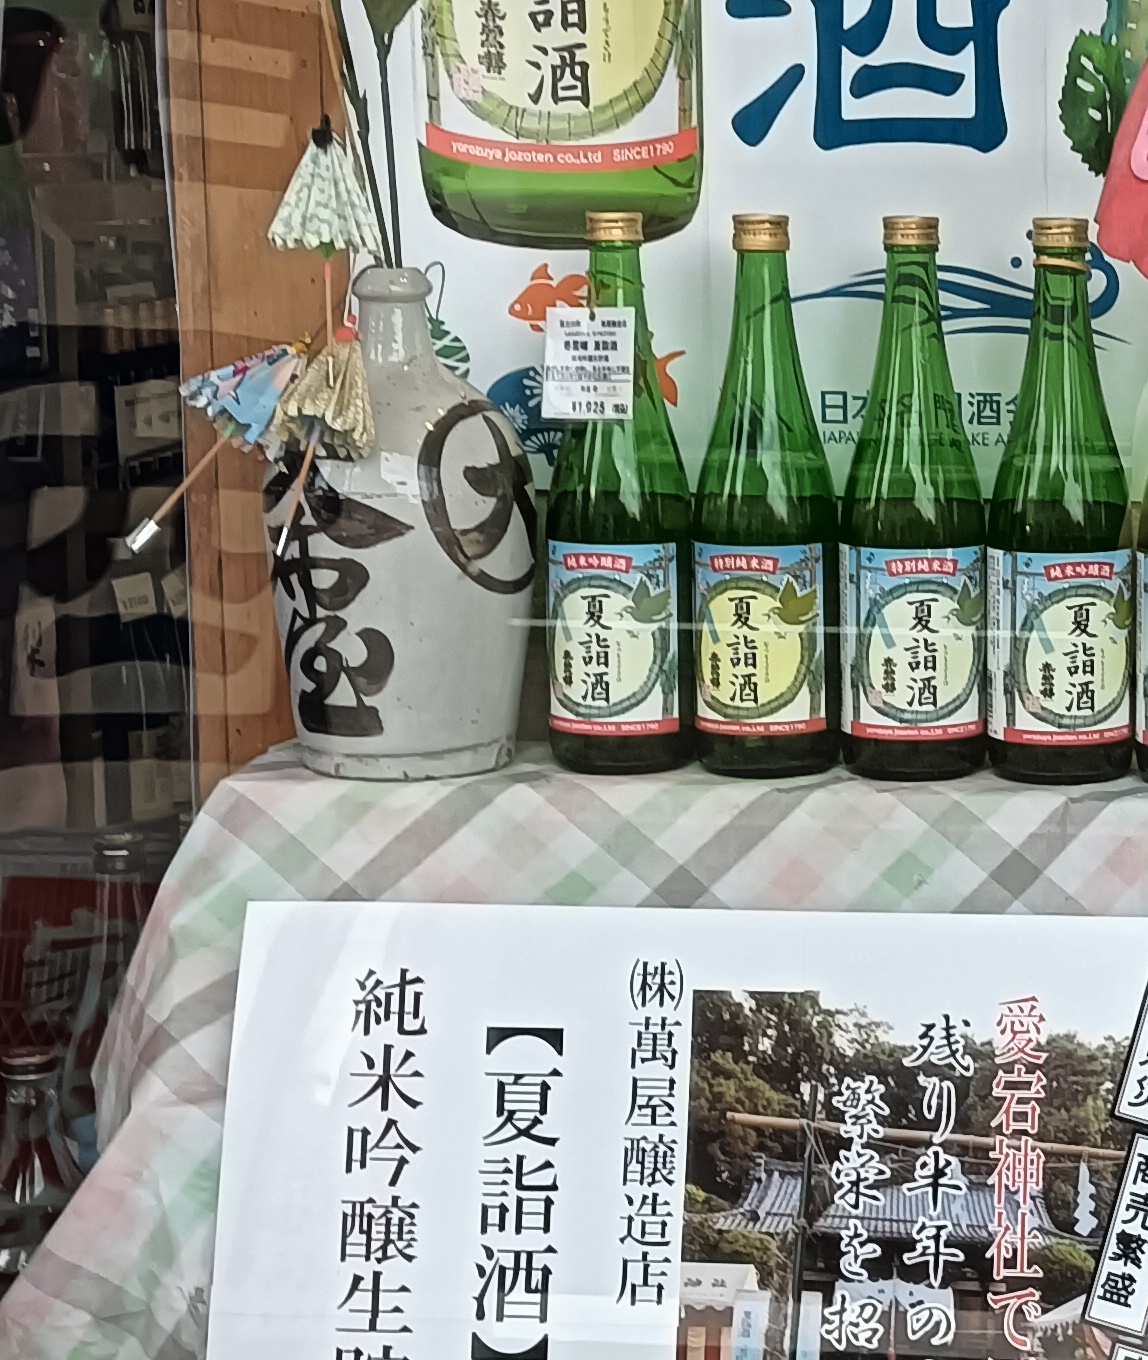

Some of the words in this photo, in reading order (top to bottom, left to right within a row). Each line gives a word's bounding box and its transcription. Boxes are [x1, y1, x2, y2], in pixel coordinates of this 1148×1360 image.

[578, 593, 613, 705] 夏詣酒
[725, 594, 760, 706] 夏詣酒
[903, 597, 941, 709] 夏詣酒
[1061, 601, 1099, 713] 夏詣酒
